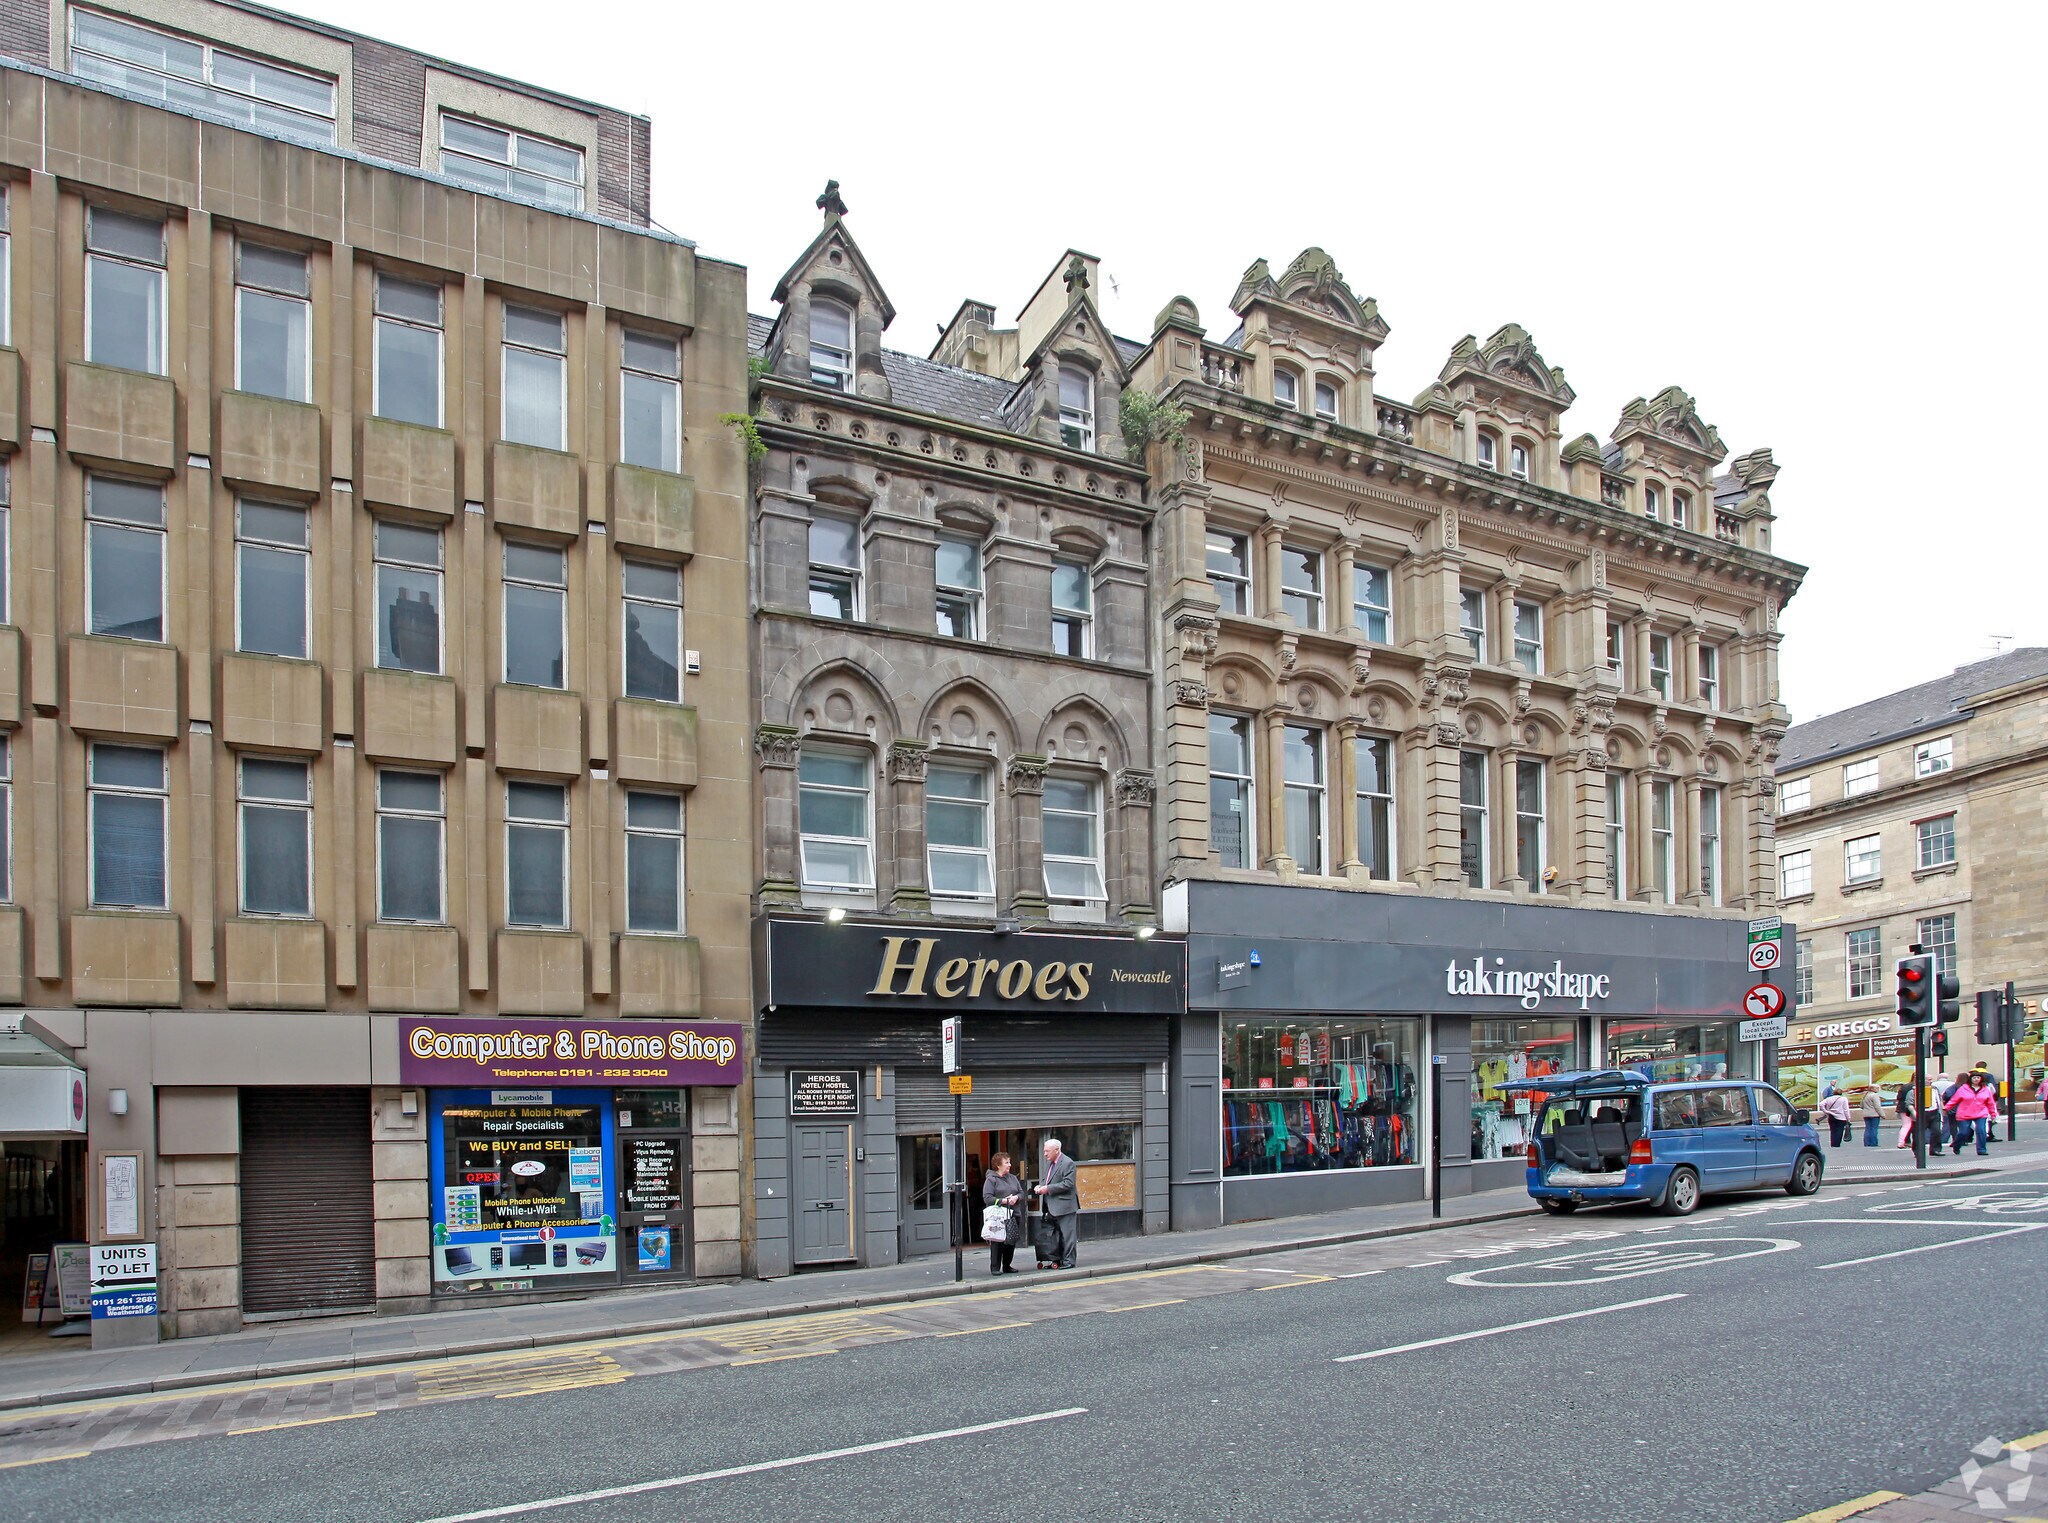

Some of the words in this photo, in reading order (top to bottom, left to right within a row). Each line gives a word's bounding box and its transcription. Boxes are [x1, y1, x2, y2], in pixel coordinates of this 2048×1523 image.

[1756, 950, 1774, 961] 20
[865, 936, 1094, 1000] Heroes
[1110, 968, 1172, 984] Newcastle
[1814, 1016, 1891, 1038] GREGGS
[411, 1028, 550, 1064] Computer
[555, 1030, 576, 1059] &
[582, 1031, 665, 1059] Phone
[670, 1032, 734, 1065] Shop
[1281, 1047, 1293, 1055] SALE
[1300, 1038, 1308, 1064] SALE
[492, 1069, 558, 1078] Telephone:
[498, 1094, 544, 1102] Lycamobile
[462, 1110, 507, 1119] Computer
[509, 1108, 516, 1116] &
[522, 1108, 551, 1116] Mobile
[554, 1108, 582, 1116] Phone
[484, 1121, 512, 1132] Repair
[516, 1121, 564, 1132] Specialists
[470, 1142, 488, 1151] We
[492, 1141, 517, 1151] BUY
[520, 1141, 541, 1150] and
[545, 1140, 575, 1150] SELL
[466, 1173, 500, 1182] OPEN
[485, 1199, 508, 1207] Mobile
[509, 1198, 530, 1206] Phone
[533, 1197, 566, 1206] Unlocking
[497, 1205, 557, 1216] While-u-Wait
[464, 1222, 504, 1232] Computer
[514, 1220, 539, 1228] Phone
[542, 1218, 589, 1227] Accessories
[102, 1248, 146, 1260] UNITS
[98, 1265, 118, 1275] TO
[124, 1263, 150, 1273] LET
